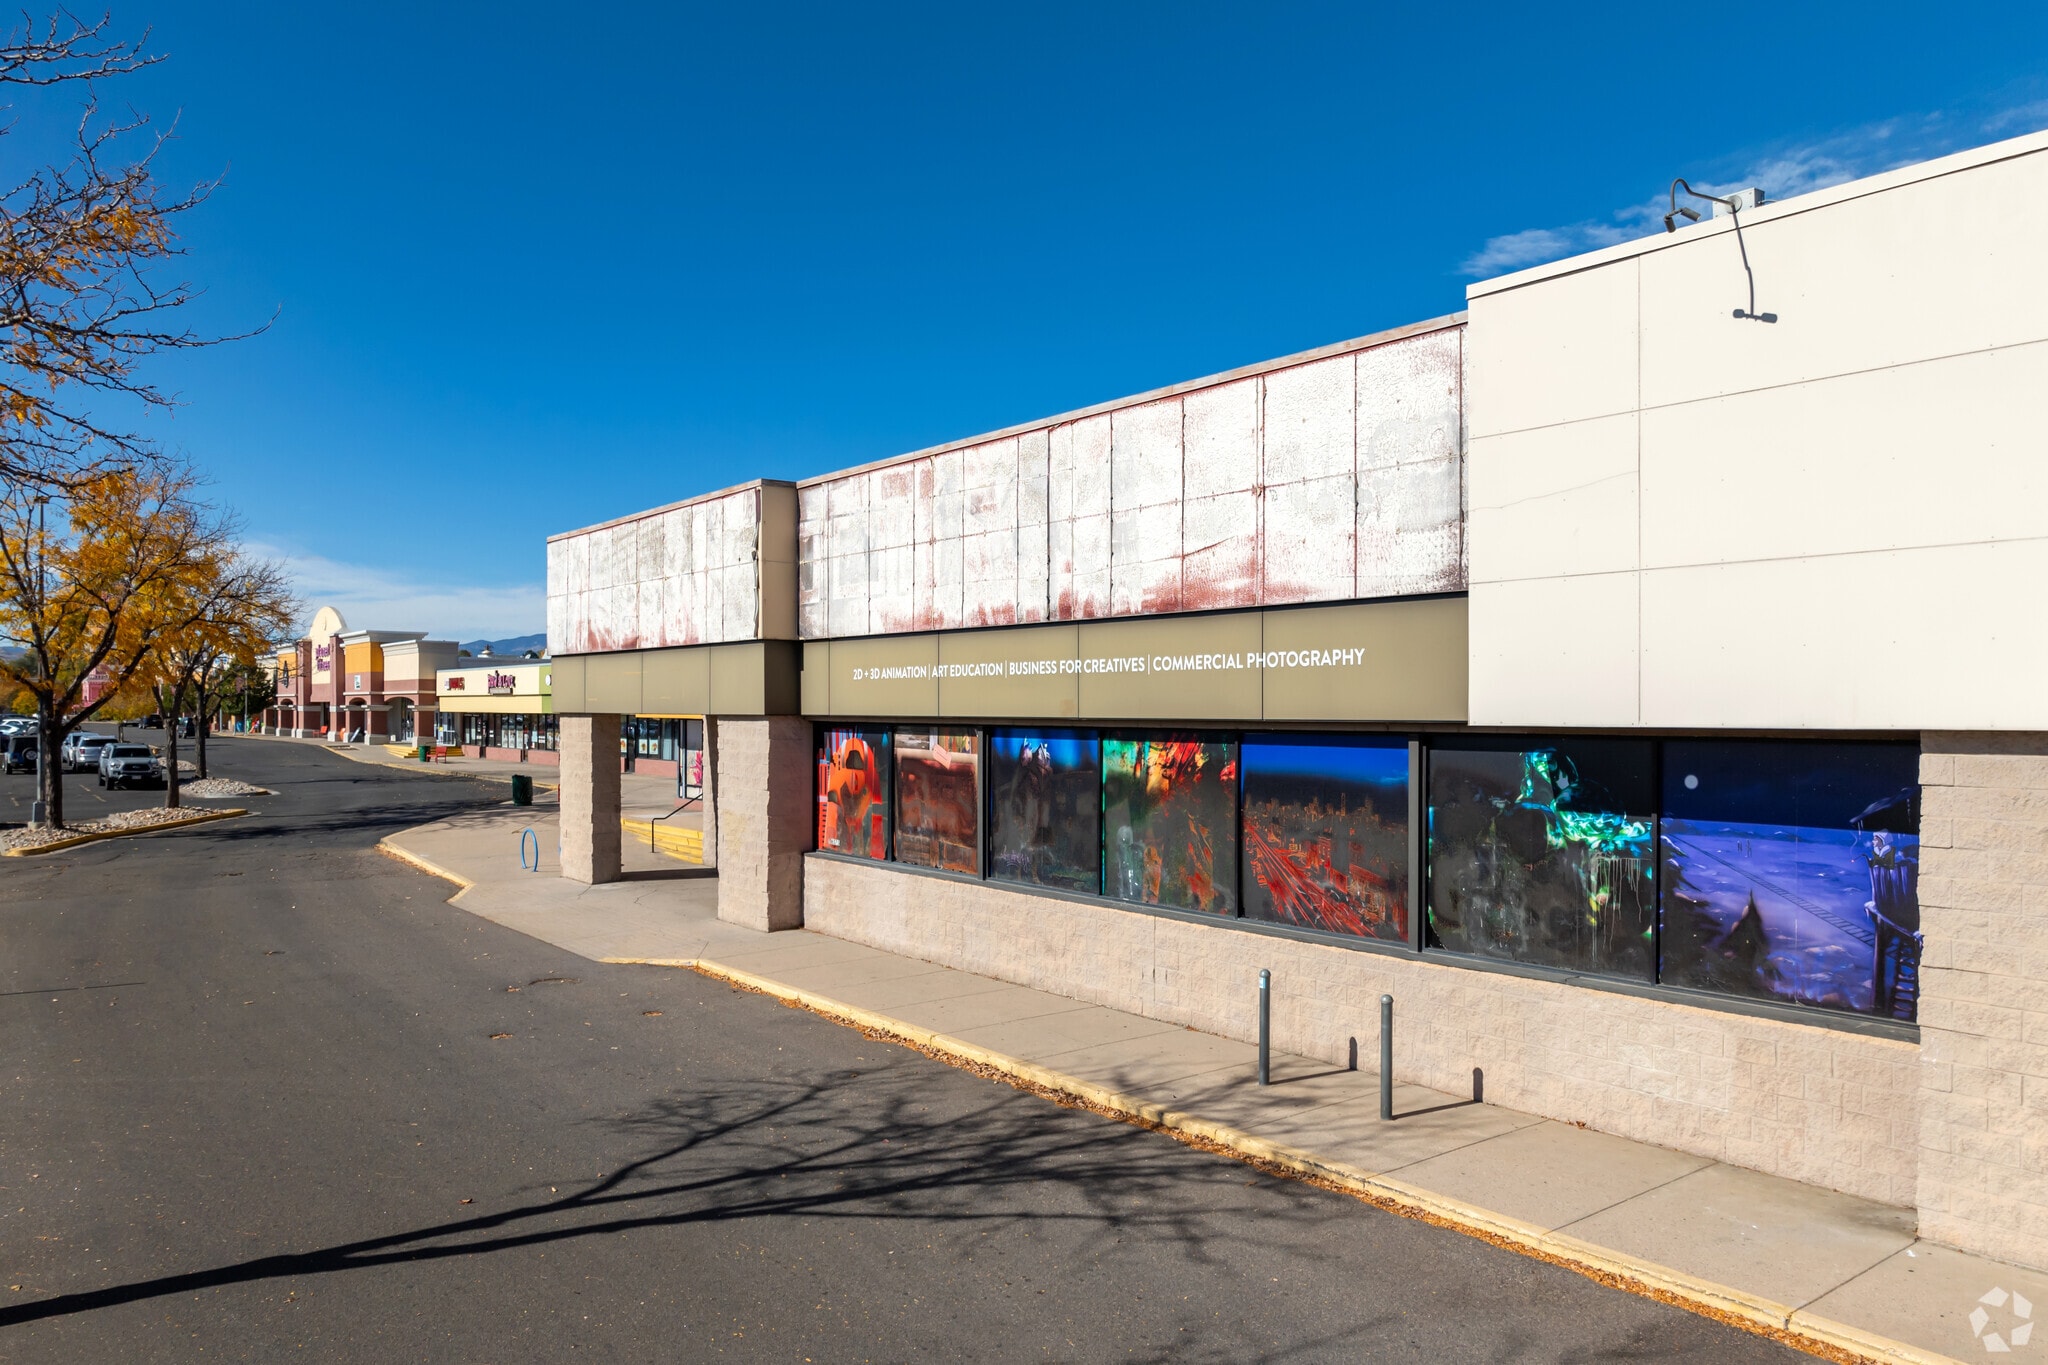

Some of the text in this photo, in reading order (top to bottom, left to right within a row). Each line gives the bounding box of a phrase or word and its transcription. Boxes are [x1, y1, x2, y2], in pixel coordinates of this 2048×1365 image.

[853, 667, 863, 680] 2D
[870, 667, 880, 680] 3D
[881, 665, 927, 680] ANIMATION
[932, 664, 948, 678] ART
[950, 662, 1003, 678] EDUCATION
[1009, 659, 1057, 676] BUSINESS
[1060, 659, 1082, 674] FOR
[1083, 657, 1145, 674] CREATIVES
[1152, 653, 1244, 672] COMMERCIAL
[1246, 648, 1366, 669] PHOTOGRAPHY
